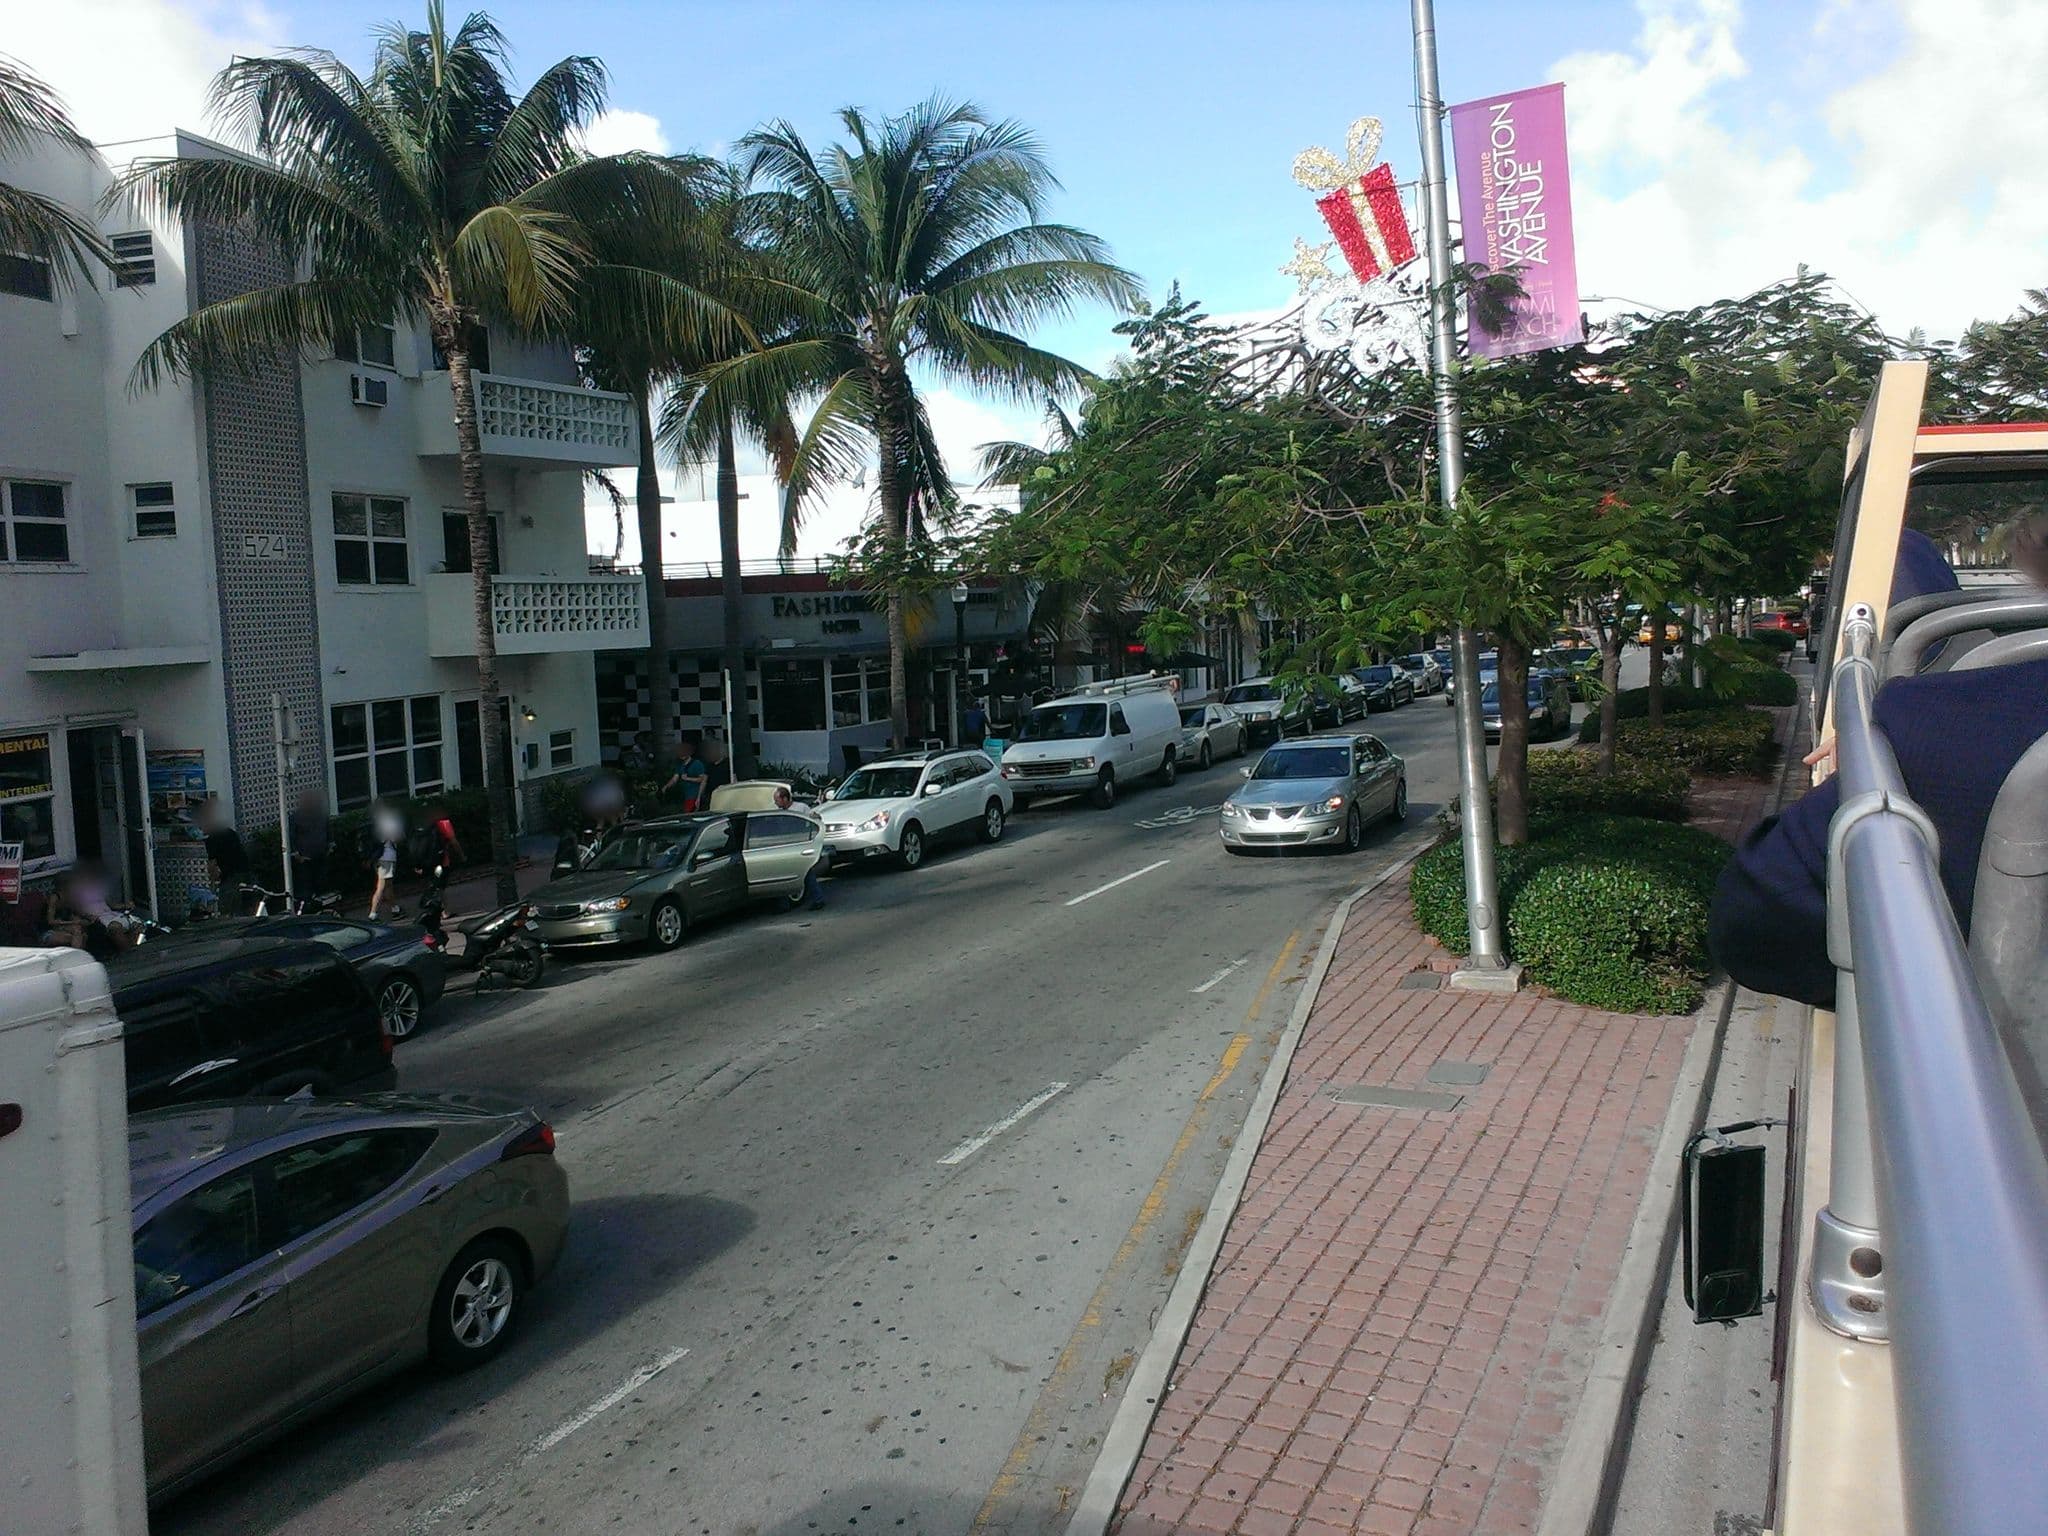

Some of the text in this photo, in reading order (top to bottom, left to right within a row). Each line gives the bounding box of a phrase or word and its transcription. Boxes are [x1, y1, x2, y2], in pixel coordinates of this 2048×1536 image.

[1480, 152, 1500, 275] iscover The Avenue
[1518, 160, 1549, 264] AVENUE
[243, 535, 286, 558] 524
